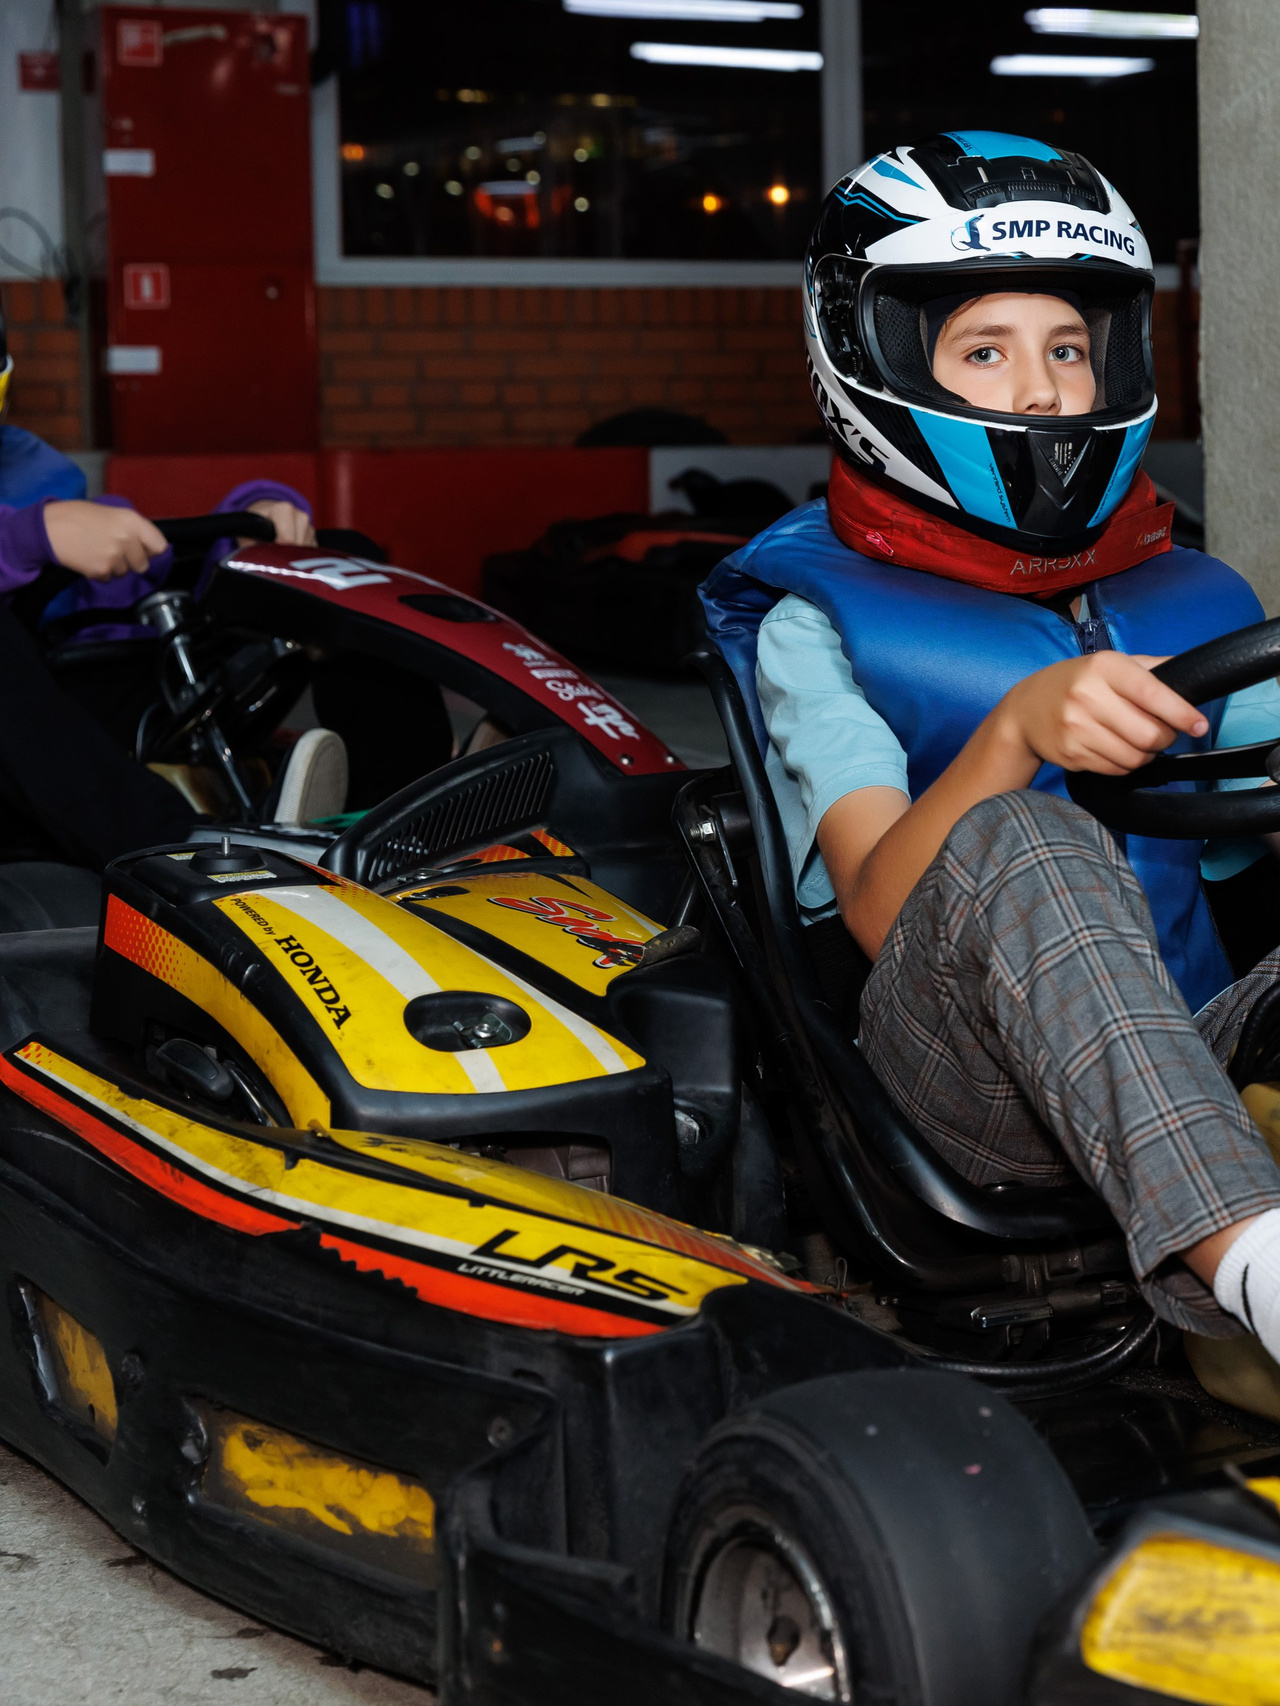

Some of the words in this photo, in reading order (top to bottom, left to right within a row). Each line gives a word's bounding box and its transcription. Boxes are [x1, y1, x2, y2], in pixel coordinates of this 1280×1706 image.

[992, 220, 1051, 241] SMP
[1057, 221, 1135, 257] RACING
[230, 897, 269, 927] POWERED
[263, 925, 277, 936] by
[274, 934, 352, 1030] HONDA
[469, 1228, 690, 1302] LRS
